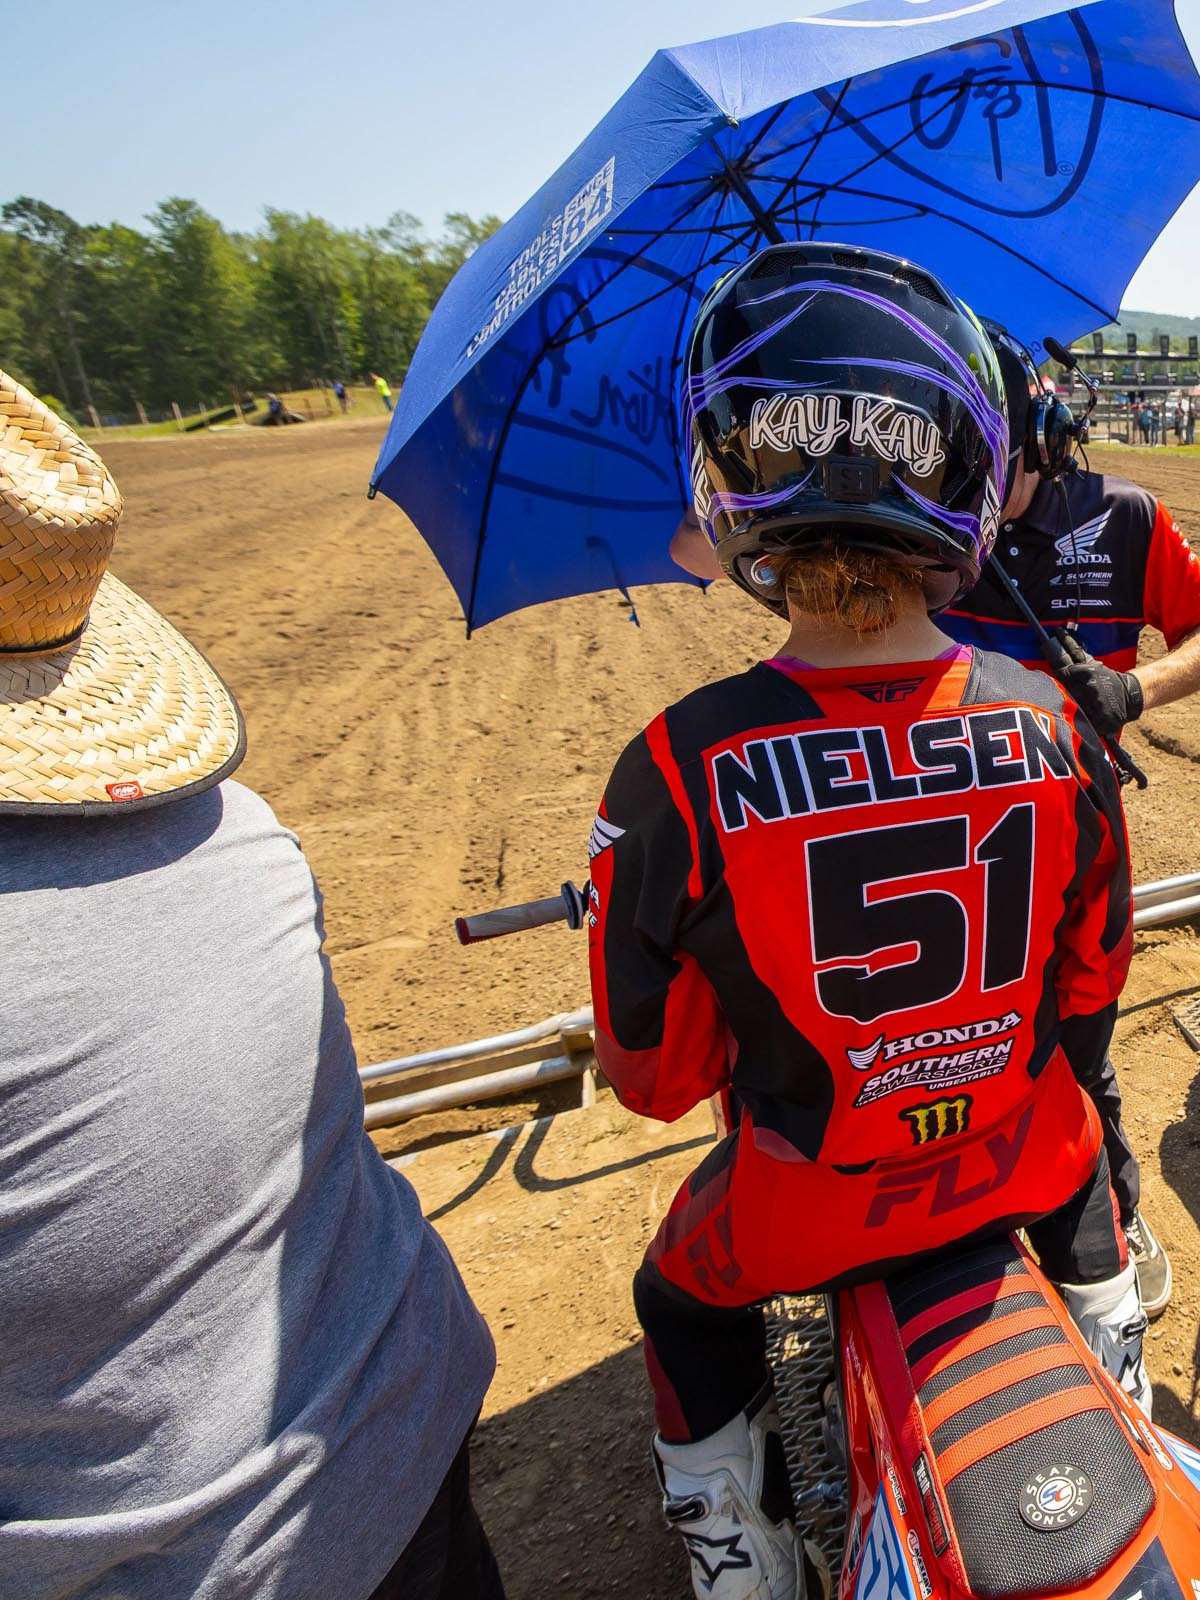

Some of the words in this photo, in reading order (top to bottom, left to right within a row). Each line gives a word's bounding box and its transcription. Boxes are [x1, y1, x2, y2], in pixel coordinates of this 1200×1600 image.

[564, 160, 613, 217] SINCE
[495, 235, 561, 311] CABLES
[509, 214, 562, 278] TOOLS
[467, 257, 557, 358] CONTROLS
[750, 393, 850, 457] KAY
[850, 395, 945, 478] KAY
[711, 707, 1071, 833] NIELSEN
[803, 802, 1036, 1025] 51
[863, 1039, 1014, 1092] SOUTHERN
[884, 1012, 1022, 1060] HONDA
[858, 1055, 1008, 1103] POWERSPORTS
[863, 1102, 1035, 1229] FLY
[1026, 1466, 1074, 1497] SEAT
[1026, 1476, 1088, 1526] CONCEPTS
